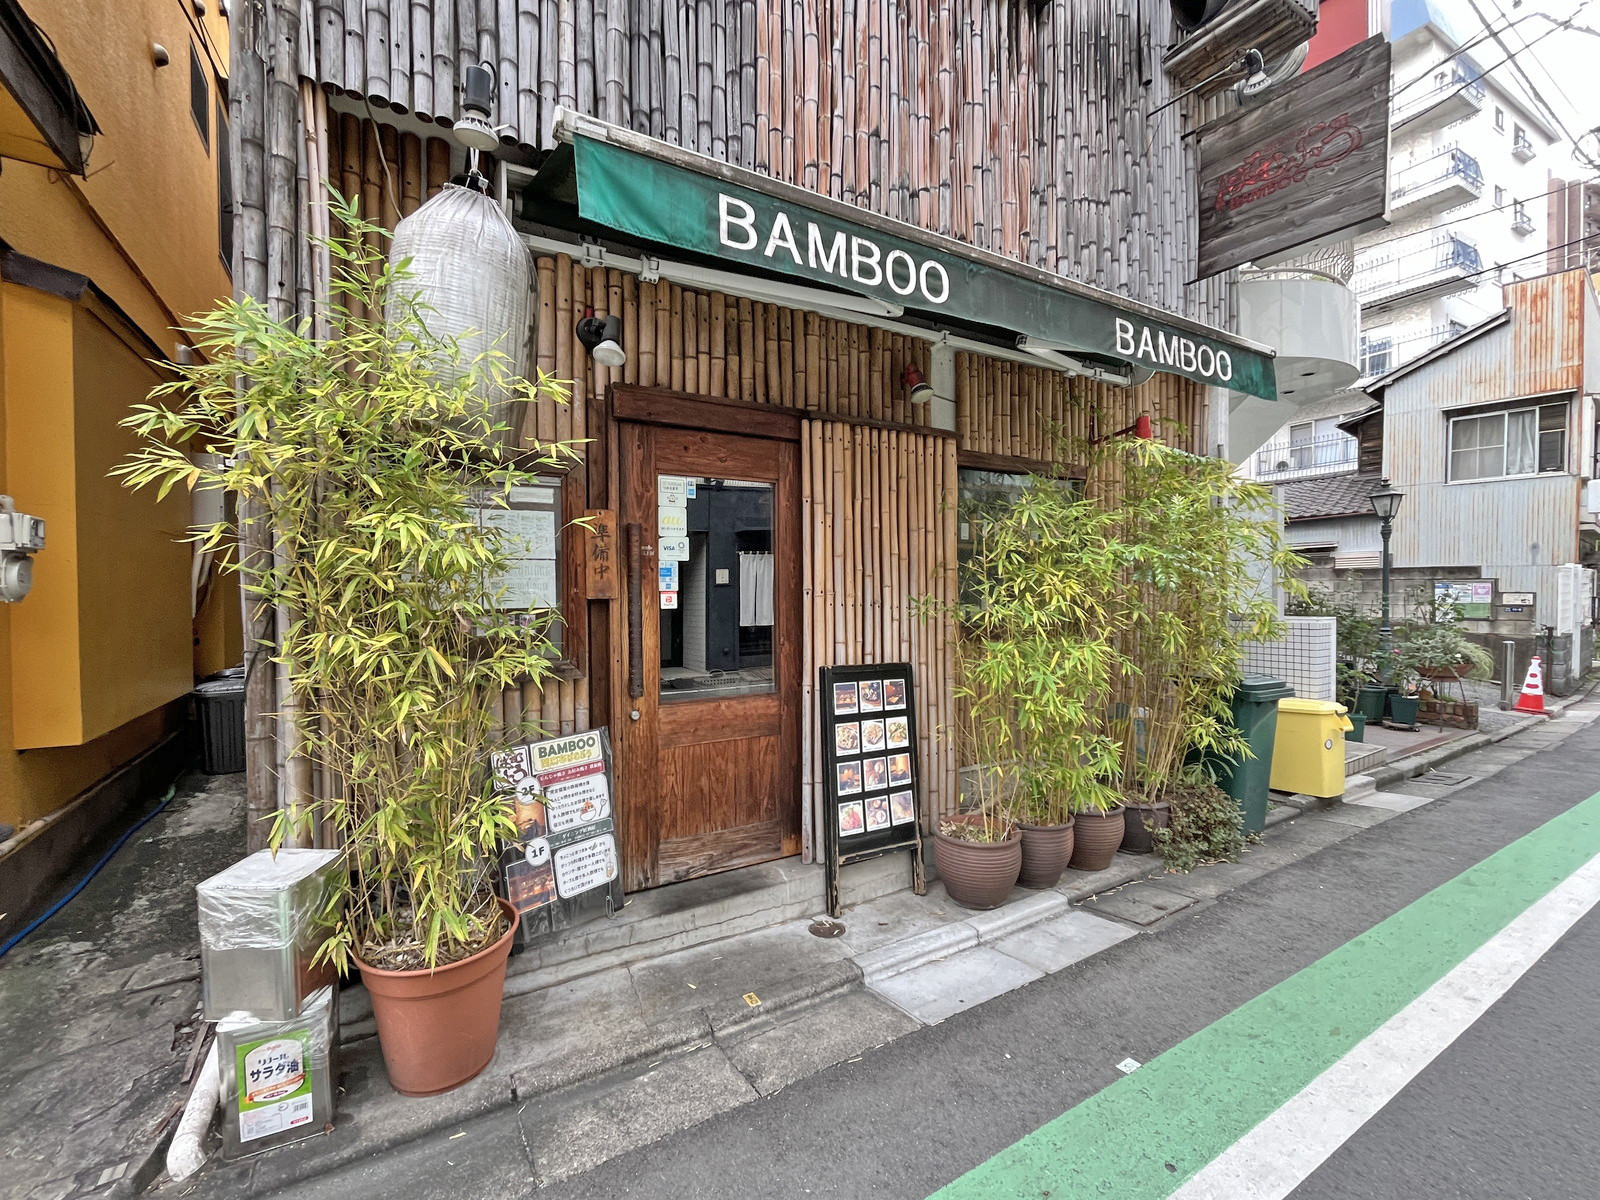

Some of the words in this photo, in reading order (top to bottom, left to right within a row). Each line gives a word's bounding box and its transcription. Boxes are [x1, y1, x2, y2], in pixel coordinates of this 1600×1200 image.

[718, 193, 949, 304] BAMBOO
[1115, 317, 1233, 381] BAMBOO
[591, 523, 611, 579] 準備中
[538, 736, 595, 758] BAMBOO
[521, 784, 535, 796] 2F
[531, 846, 545, 859] 1F
[250, 1059, 299, 1083] サラダ油
